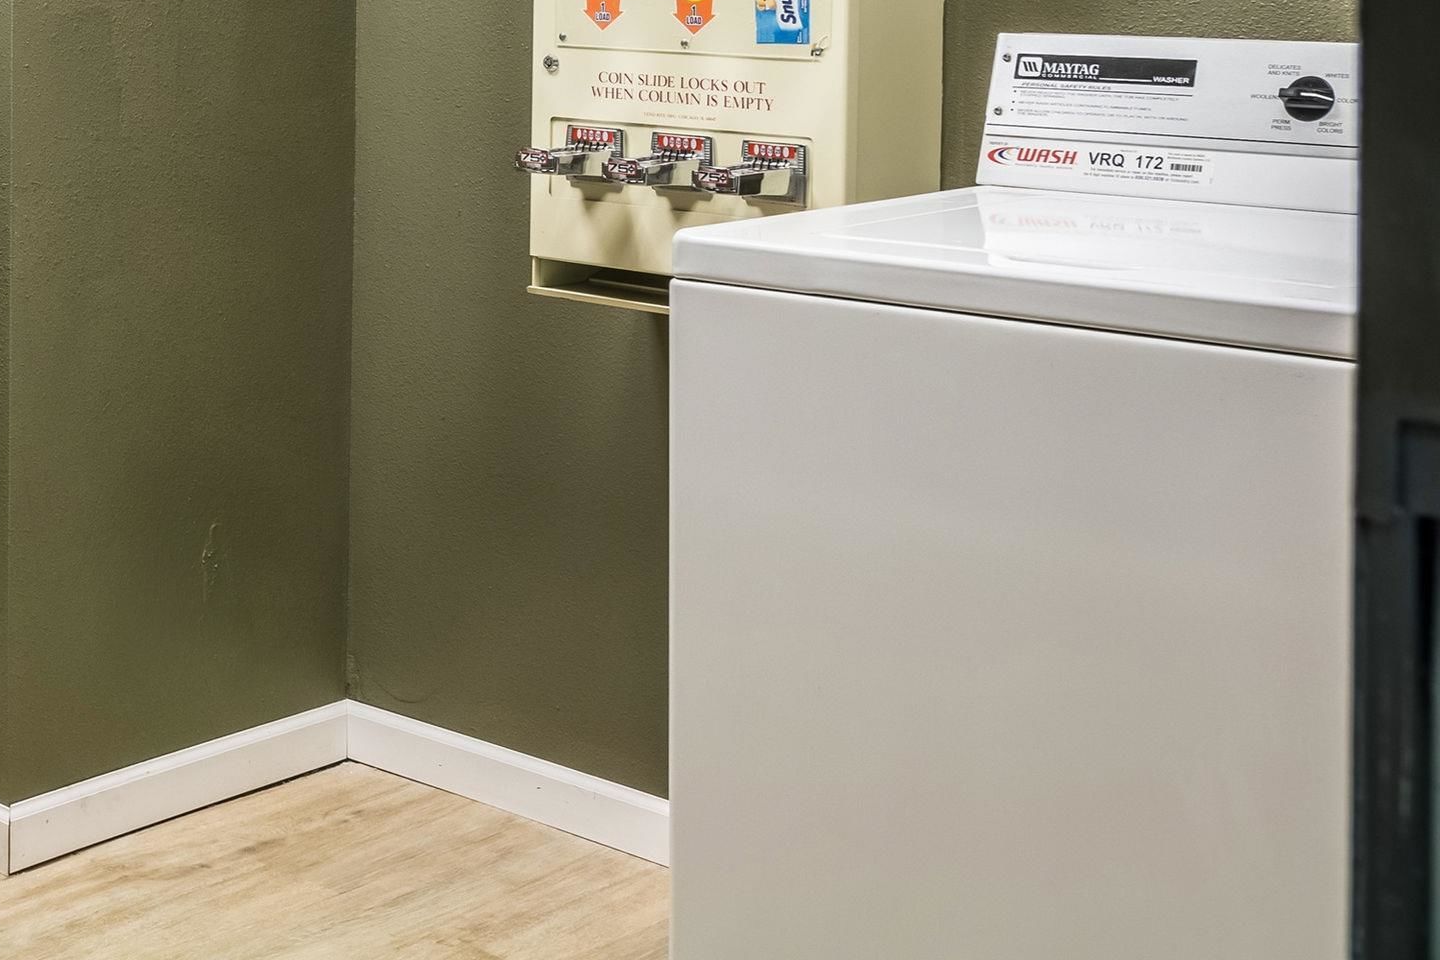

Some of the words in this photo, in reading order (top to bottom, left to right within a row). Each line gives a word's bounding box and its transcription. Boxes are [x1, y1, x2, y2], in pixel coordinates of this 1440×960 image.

[595, 12, 611, 20] LOAD
[686, 16, 702, 24] LOAD
[1042, 62, 1100, 76] MAYTAG
[598, 71, 634, 85] COIN
[638, 74, 675, 88] SLIDE
[680, 77, 728, 92] LOCKS
[733, 80, 766, 95] OUT
[1152, 76, 1190, 84] WASHER
[591, 86, 633, 100] WHEN
[638, 90, 701, 105] COLUMN
[706, 94, 718, 107] IS
[723, 95, 774, 111] EMPTY
[1016, 148, 1078, 165] WASH
[1088, 151, 1125, 167] VRQ
[1135, 155, 1164, 170] 172
